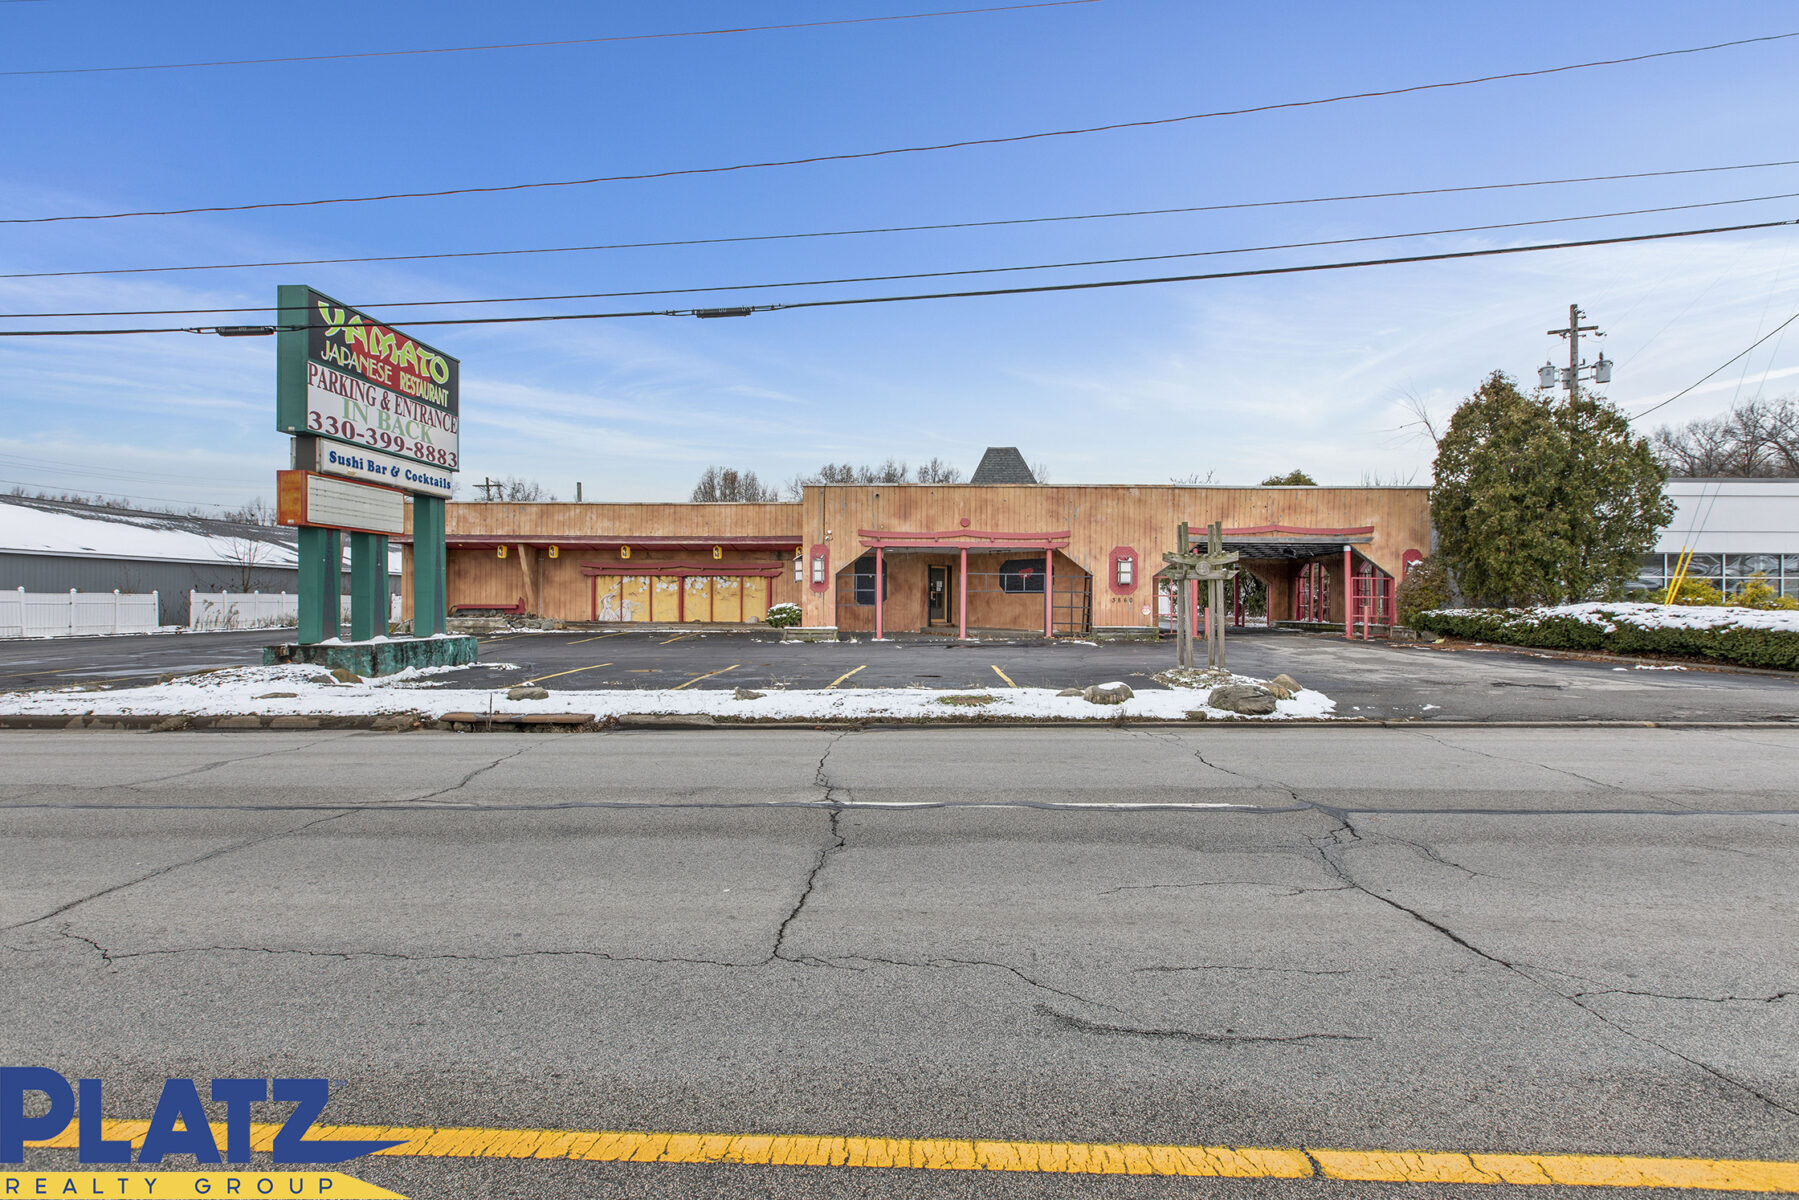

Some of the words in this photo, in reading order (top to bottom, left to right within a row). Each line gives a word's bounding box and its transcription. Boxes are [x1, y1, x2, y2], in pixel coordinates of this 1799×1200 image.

[318, 300, 449, 384] YAMATO
[308, 362, 377, 407] PARKING
[381, 390, 391, 412] &
[394, 394, 458, 434] ENTRANCE
[321, 340, 393, 385] JAPANESE
[400, 372, 449, 408] RESTAURANT
[308, 411, 457, 468] 330-399-8883
[342, 398, 369, 425] IN
[377, 409, 433, 444] BACK
[329, 451, 363, 470] Sushi
[367, 460, 387, 475] Bar
[391, 466, 400, 477] &
[405, 469, 451, 490] Cocktails
